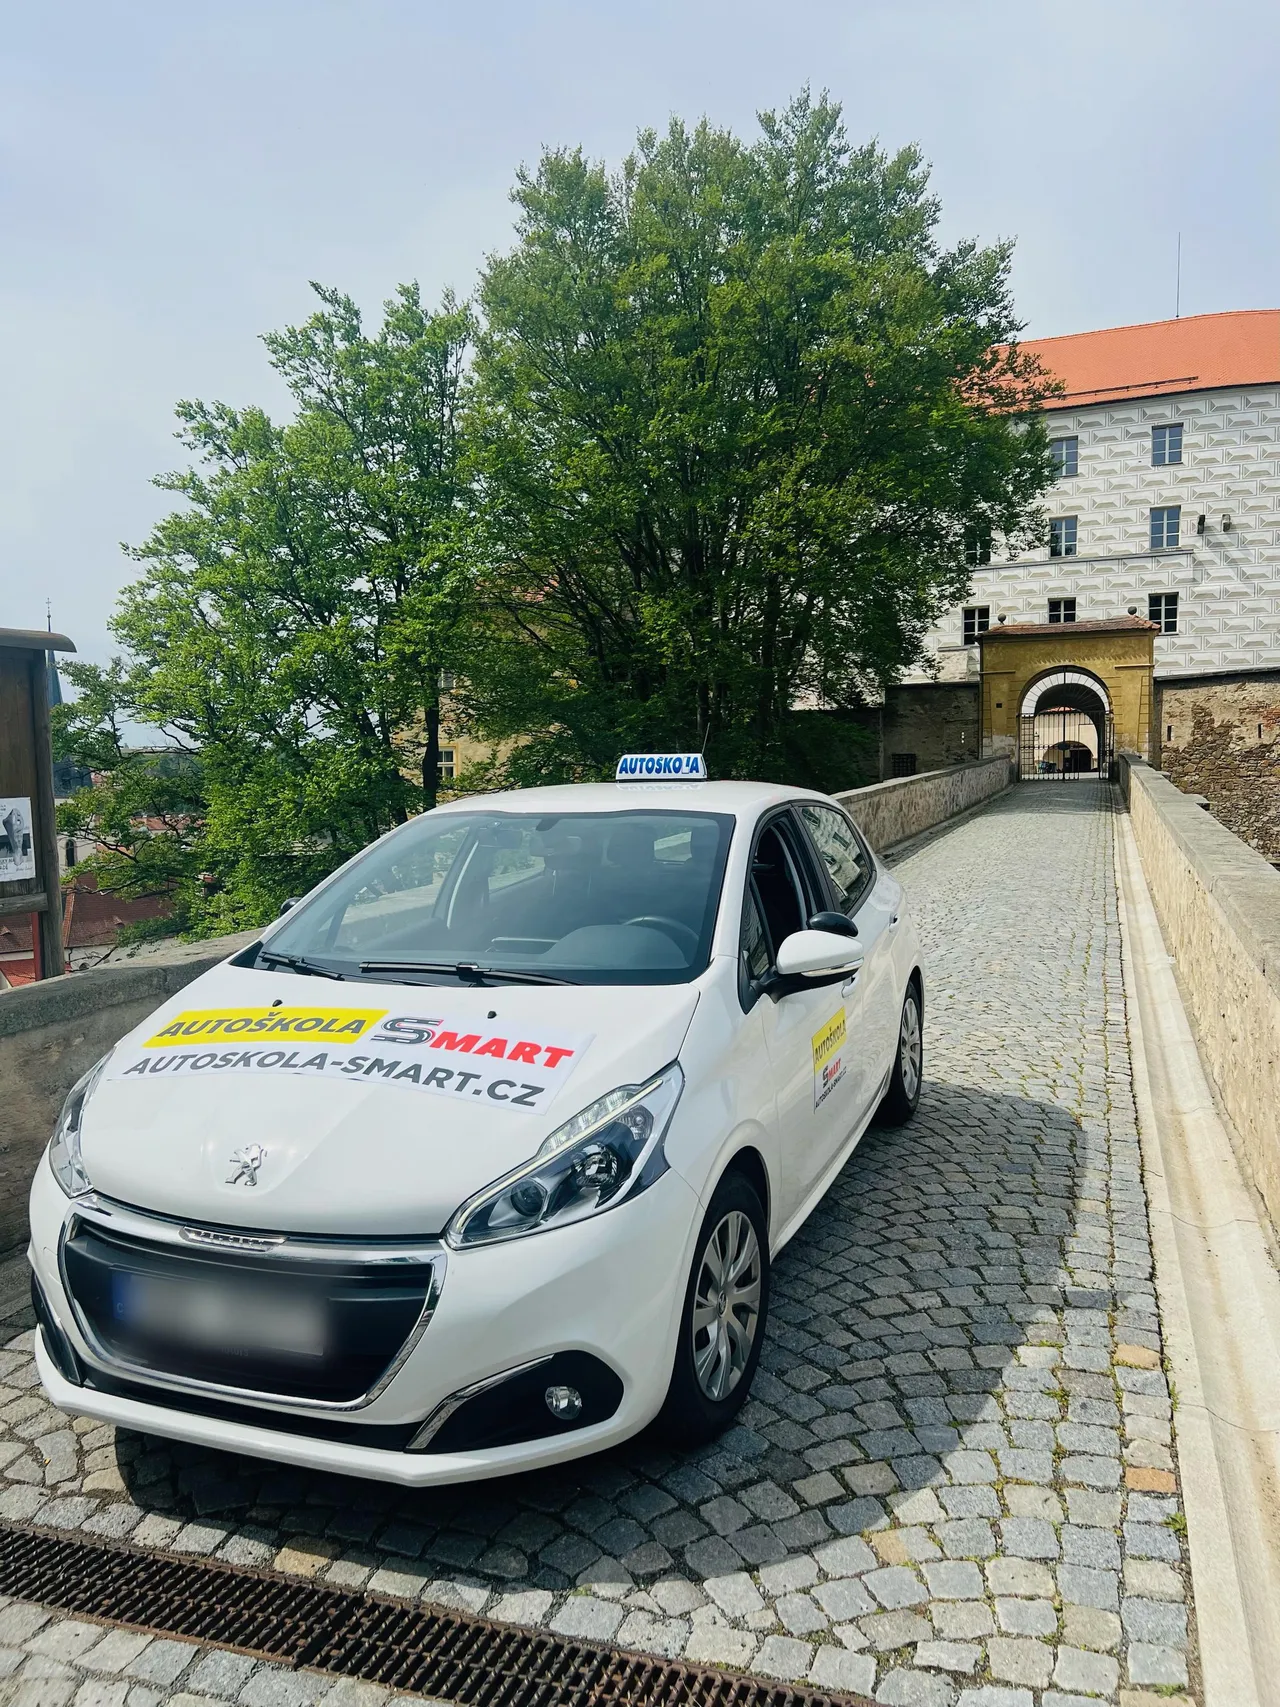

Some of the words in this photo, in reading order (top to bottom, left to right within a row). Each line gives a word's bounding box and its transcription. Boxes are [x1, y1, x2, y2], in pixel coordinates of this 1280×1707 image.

[156, 1011, 367, 1037] AUTOŠKOLA
[370, 1017, 575, 1068] SMART
[122, 1051, 545, 1107] AUTOSKOLA-SMART.CZ
